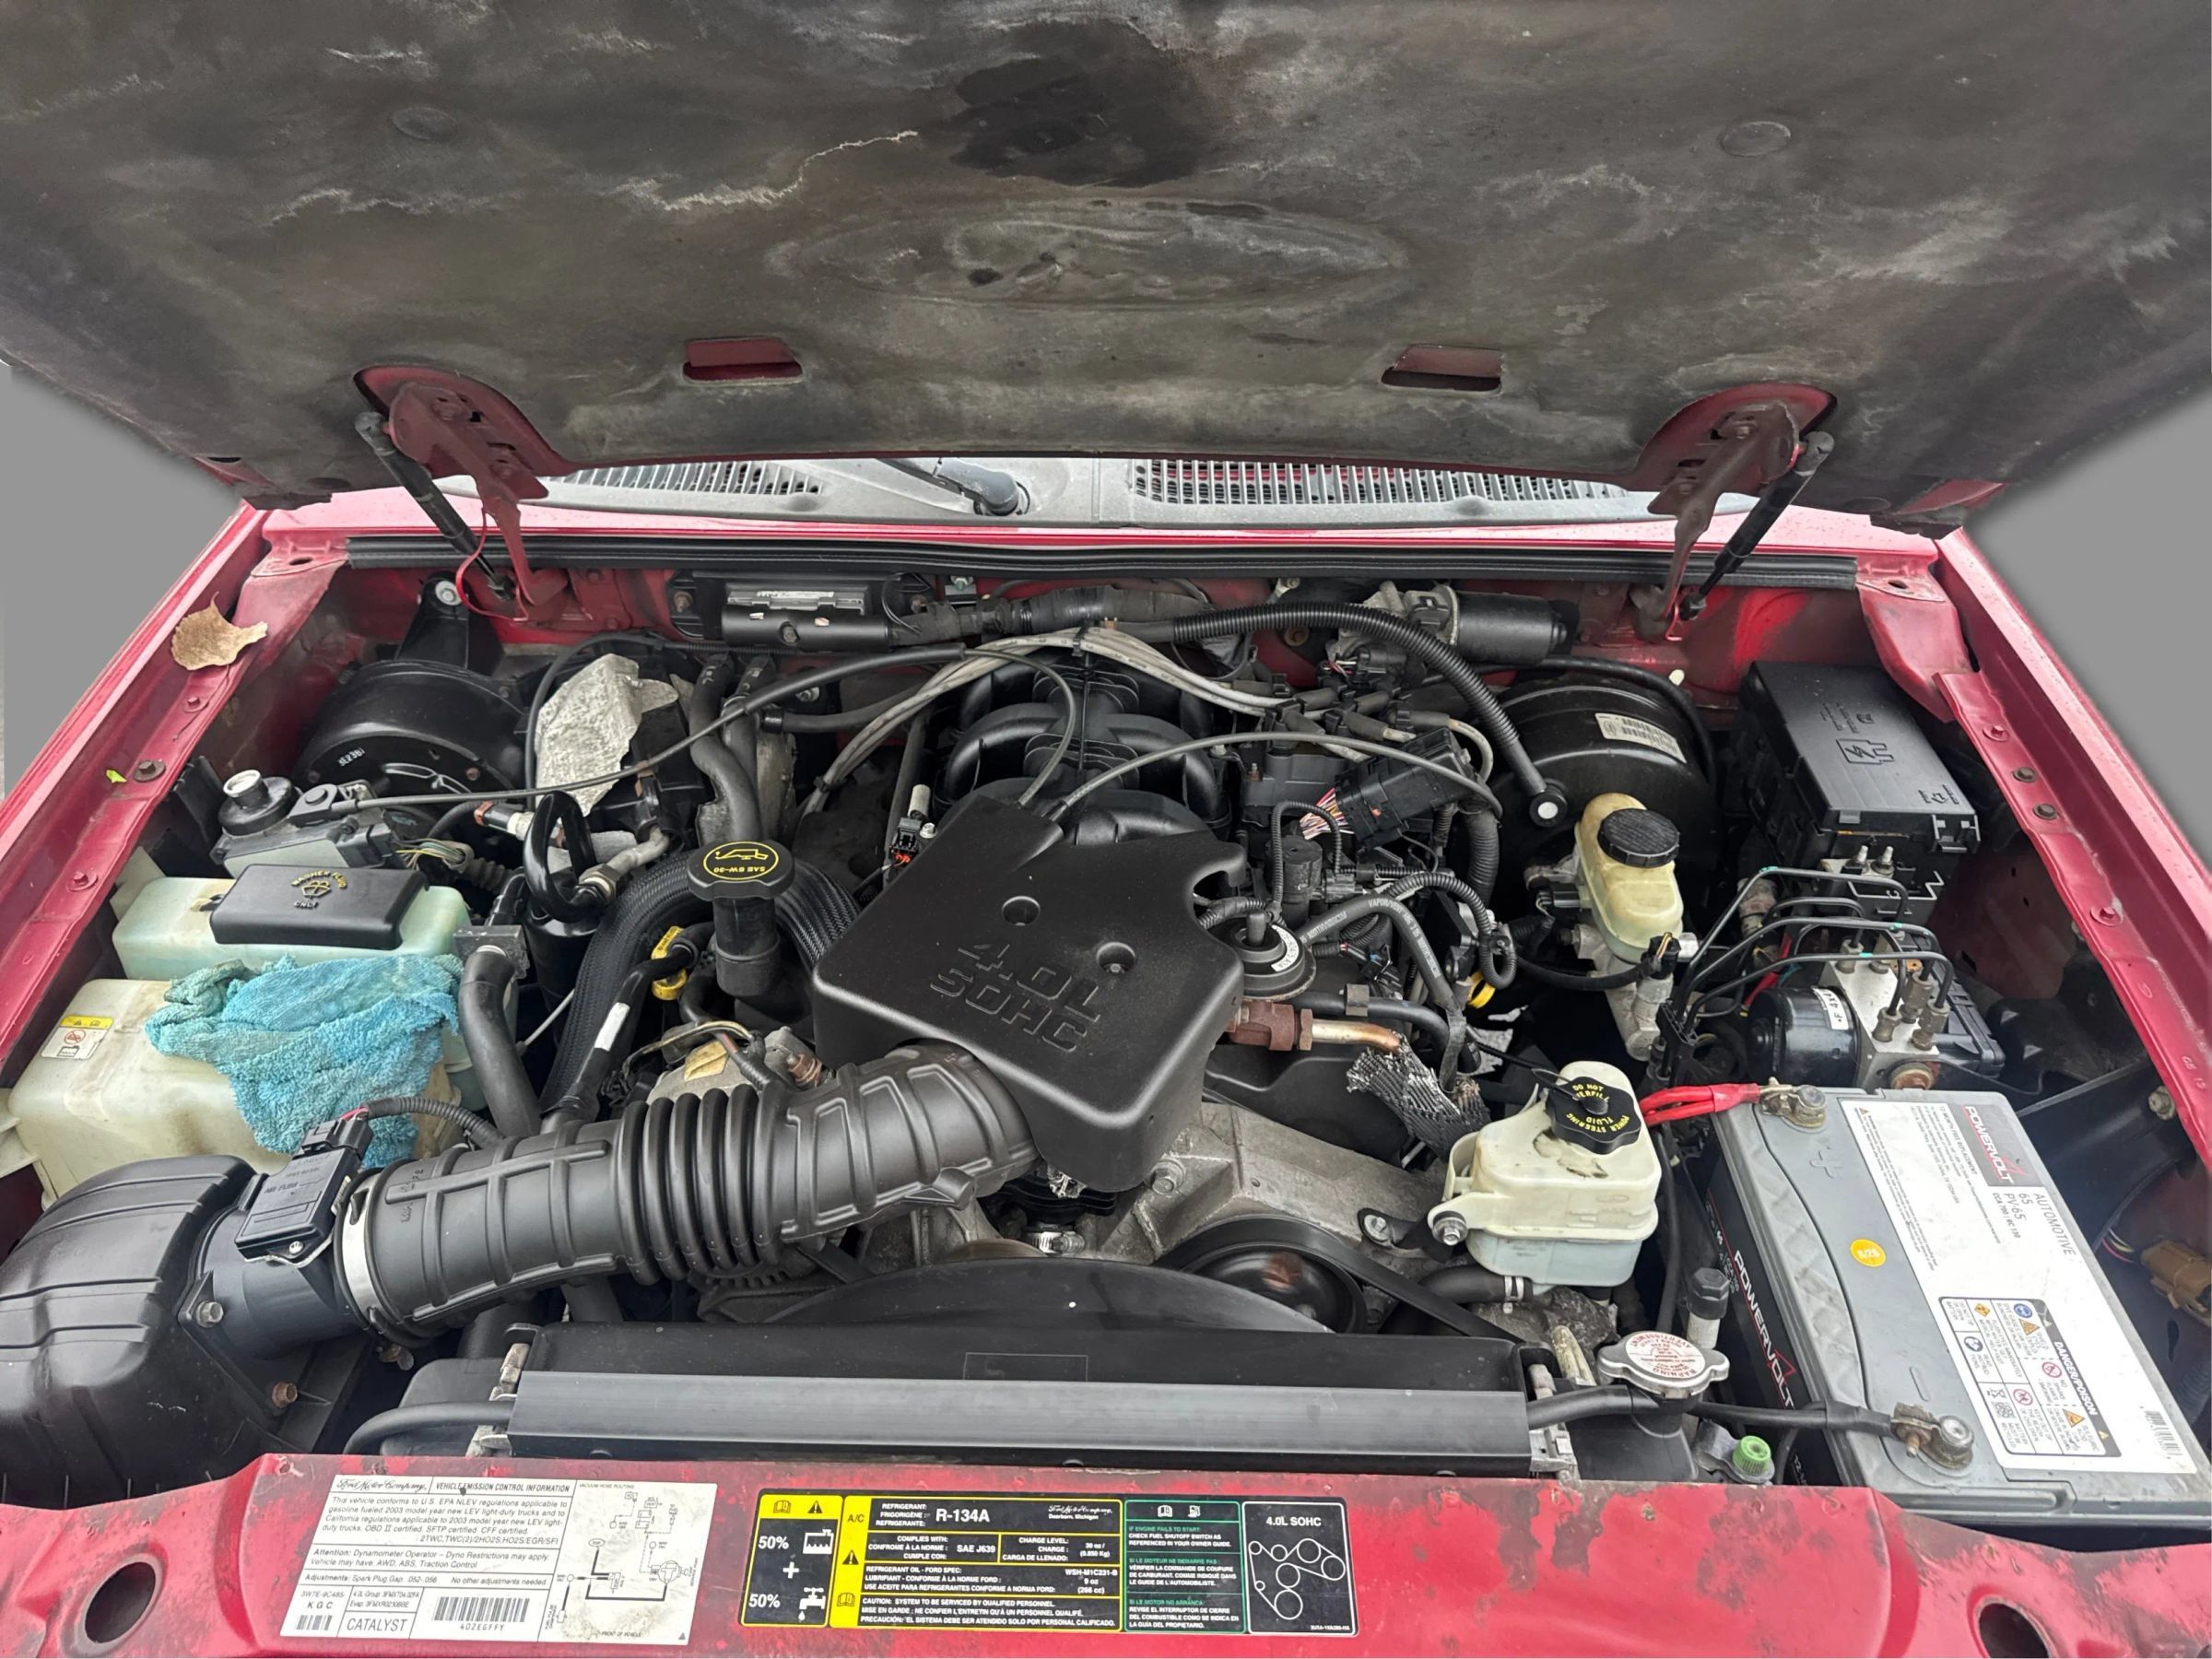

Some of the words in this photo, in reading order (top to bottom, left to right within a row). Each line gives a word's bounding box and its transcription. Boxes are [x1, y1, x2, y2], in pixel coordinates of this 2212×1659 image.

[957, 943, 1101, 1023] 4.0L
[930, 968, 1088, 1053] SOHC
[1576, 1091, 1610, 1102] ERFILL
[1567, 1113, 1606, 1133] STEERING
[1586, 1116, 1614, 1125] FLUID
[1611, 1115, 1630, 1132] POWER
[1965, 1106, 2014, 1184] POWERVOLT
[1993, 1193, 2002, 1204] CCA
[1999, 1205, 2008, 1218] 700
[2019, 1193, 2033, 1205] 65
[2005, 1193, 2027, 1220] PV-65
[2034, 1193, 2077, 1255] AUTOMOTIVE
[1734, 1250, 1795, 1409] POWERVOLT
[2053, 1341, 2099, 1416] DANGER/POISON
[336, 1479, 359, 1490] Ford
[359, 1479, 383, 1492] Motor
[495, 1483, 524, 1491] CONTROL
[526, 1484, 570, 1492] INFORMATION
[329, 1506, 359, 1514] gasoline
[482, 1508, 515, 1516] light-duty
[935, 1509, 990, 1523] R-134A
[361, 1515, 400, 1524] regulations
[402, 1516, 438, 1524] applicable
[545, 1519, 563, 1527] light-
[848, 1514, 865, 1523] A/C
[1266, 1516, 1288, 1525] 4.0L
[1290, 1517, 1322, 1526] SOHC
[323, 1524, 336, 1533] duty
[759, 1536, 789, 1549] 50%
[313, 1548, 351, 1557] Attention:
[354, 1549, 403, 1558] Dynamometer
[406, 1550, 437, 1559] Operator
[446, 1551, 465, 1559] Dyno
[372, 1575, 387, 1583] Plug
[748, 1594, 781, 1608] 50%
[347, 1618, 407, 1631] CATALYST
